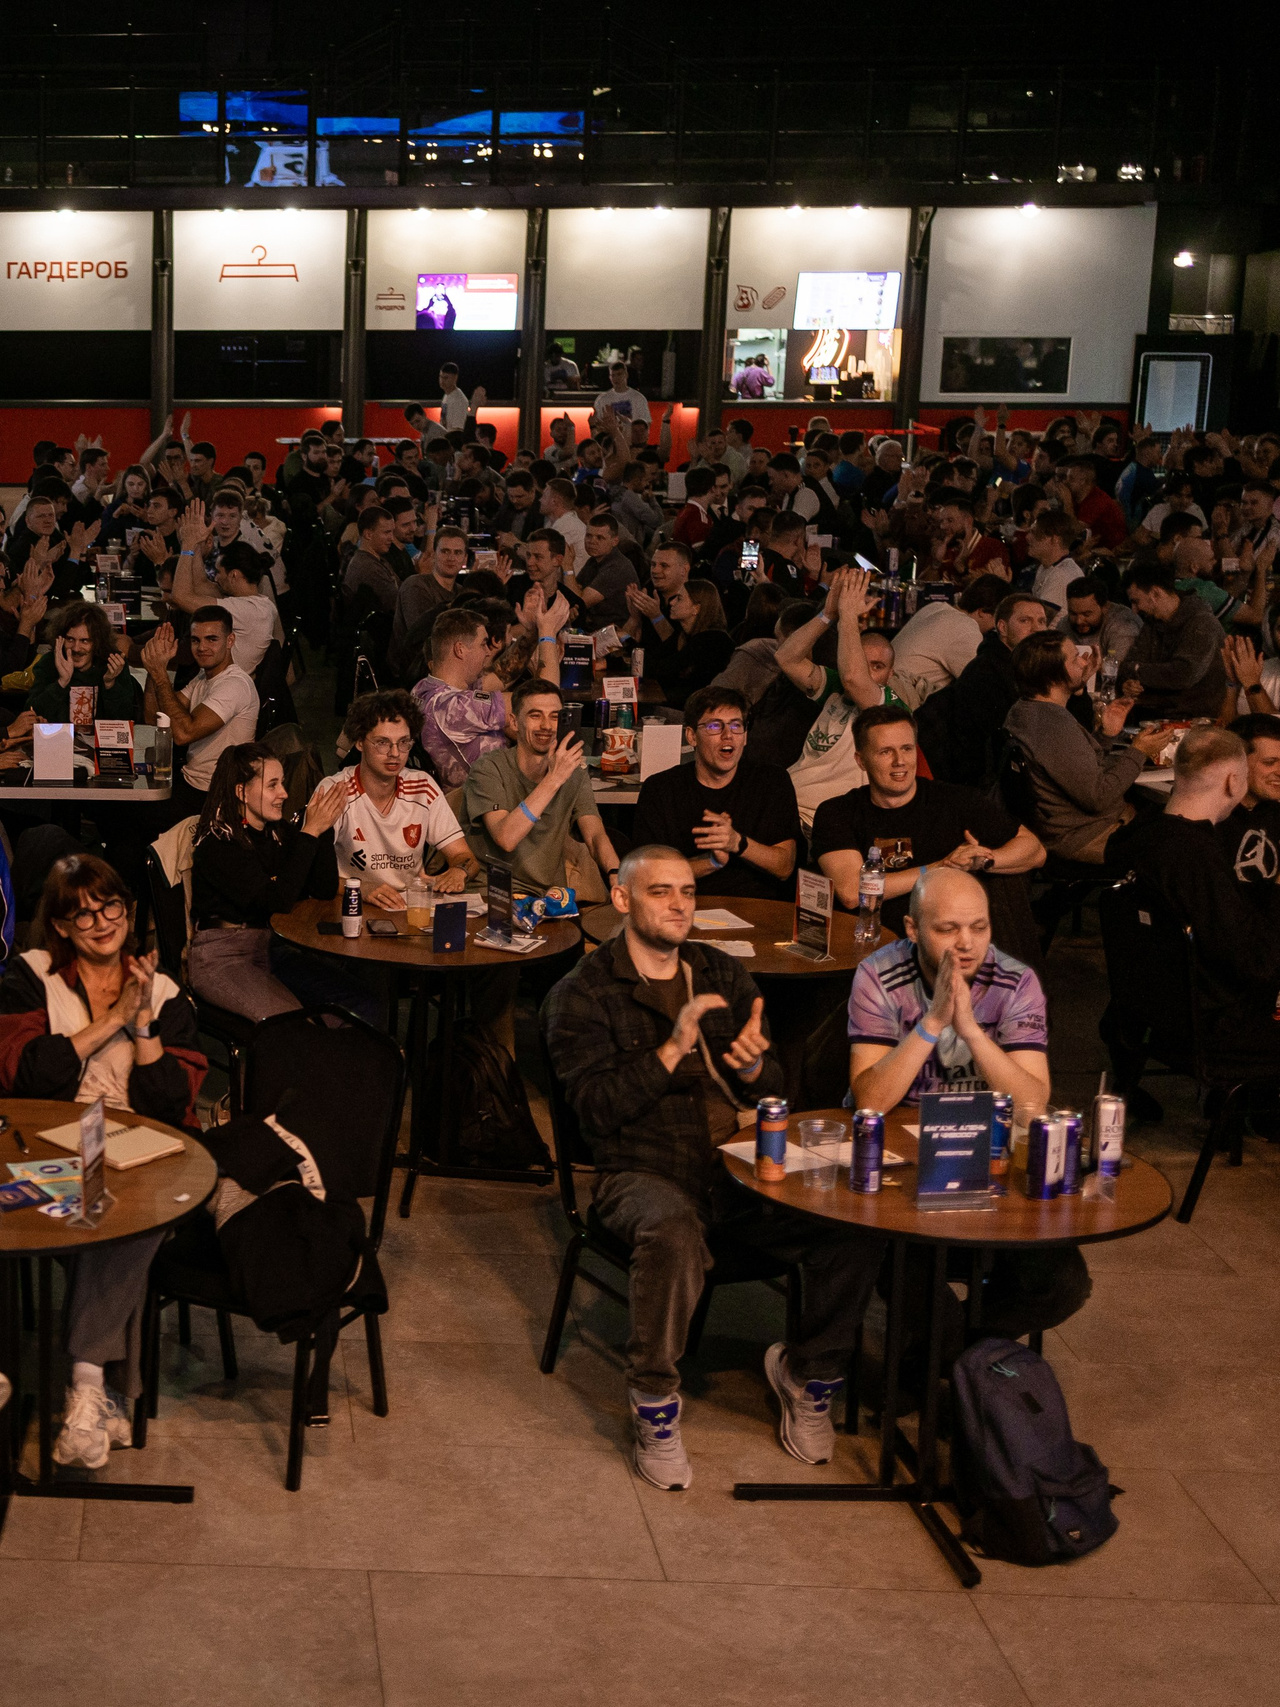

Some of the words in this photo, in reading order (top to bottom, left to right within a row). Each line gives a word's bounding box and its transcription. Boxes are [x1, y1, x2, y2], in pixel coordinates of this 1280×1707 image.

[6, 261, 128, 282] ГАРДЕРОБ
[370, 853, 413, 863] standard
[370, 858, 415, 870] chartered
[349, 890, 359, 915] Rich
